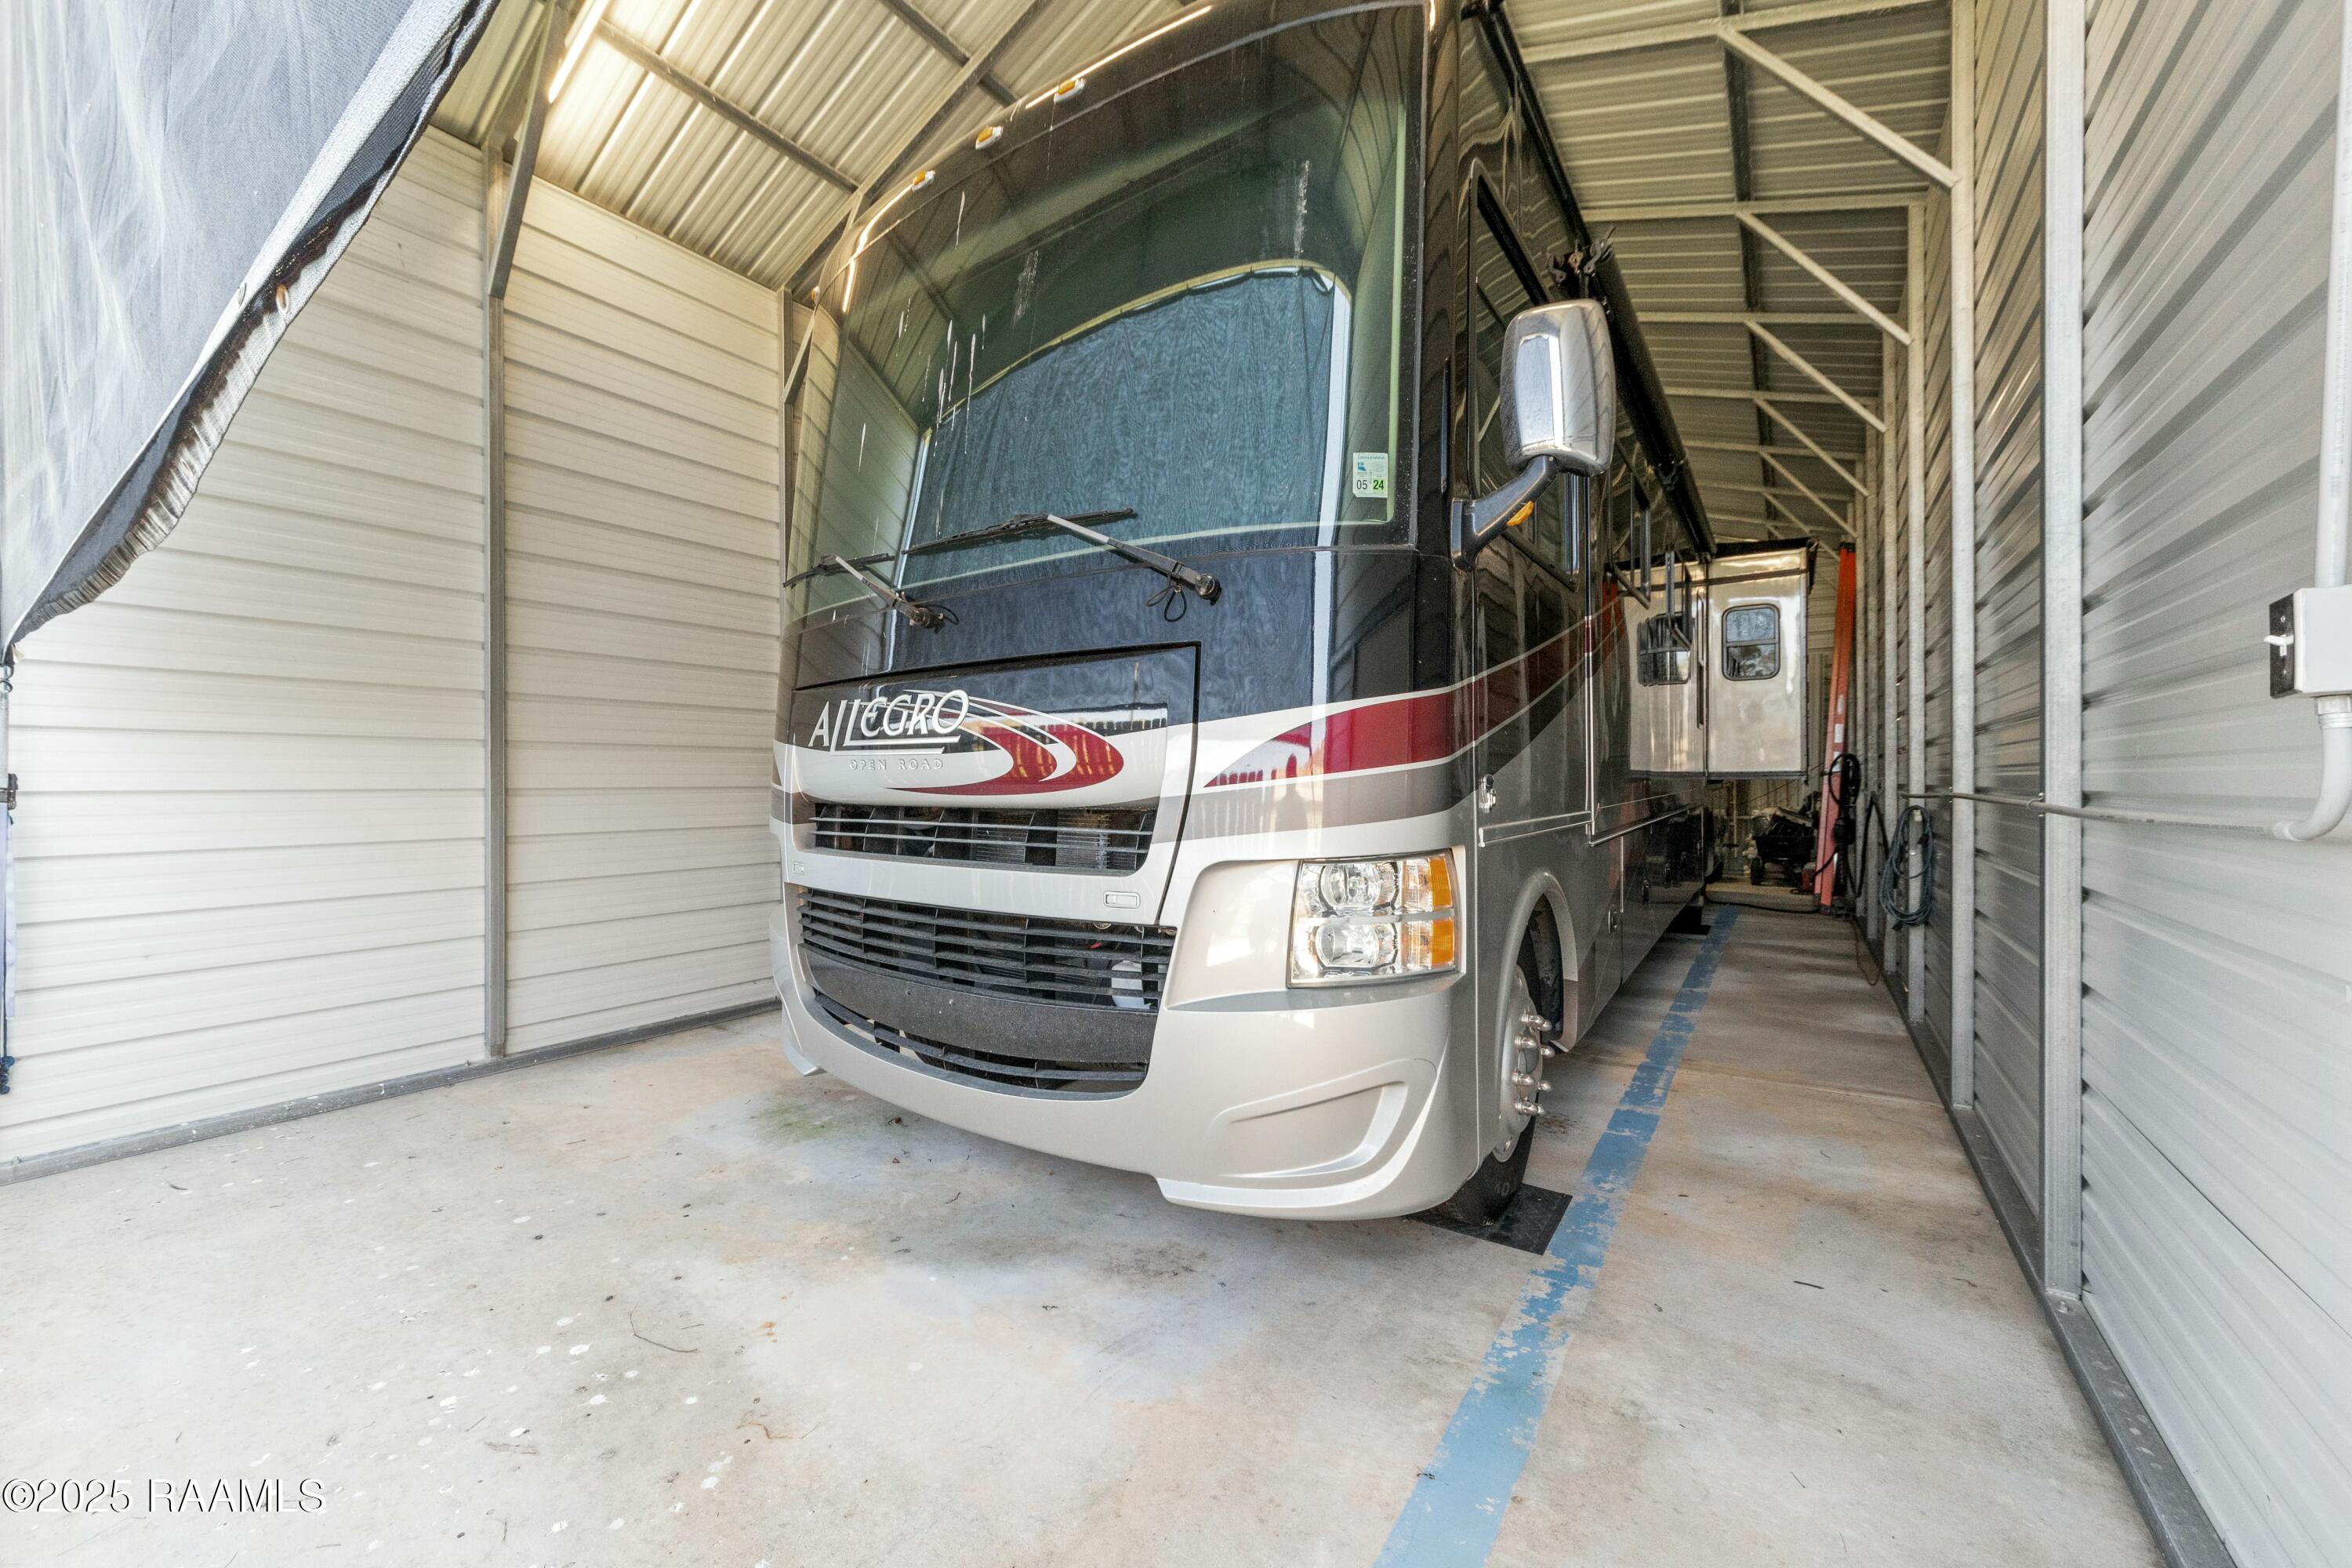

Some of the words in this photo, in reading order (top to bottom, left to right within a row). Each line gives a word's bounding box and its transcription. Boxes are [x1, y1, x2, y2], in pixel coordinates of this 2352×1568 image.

[1356, 479, 1368, 490] 05
[1373, 479, 1385, 490] 24
[808, 689, 970, 755] ALLEGRO
[848, 758, 887, 771] OPEN
[898, 758, 944, 771] ROAD
